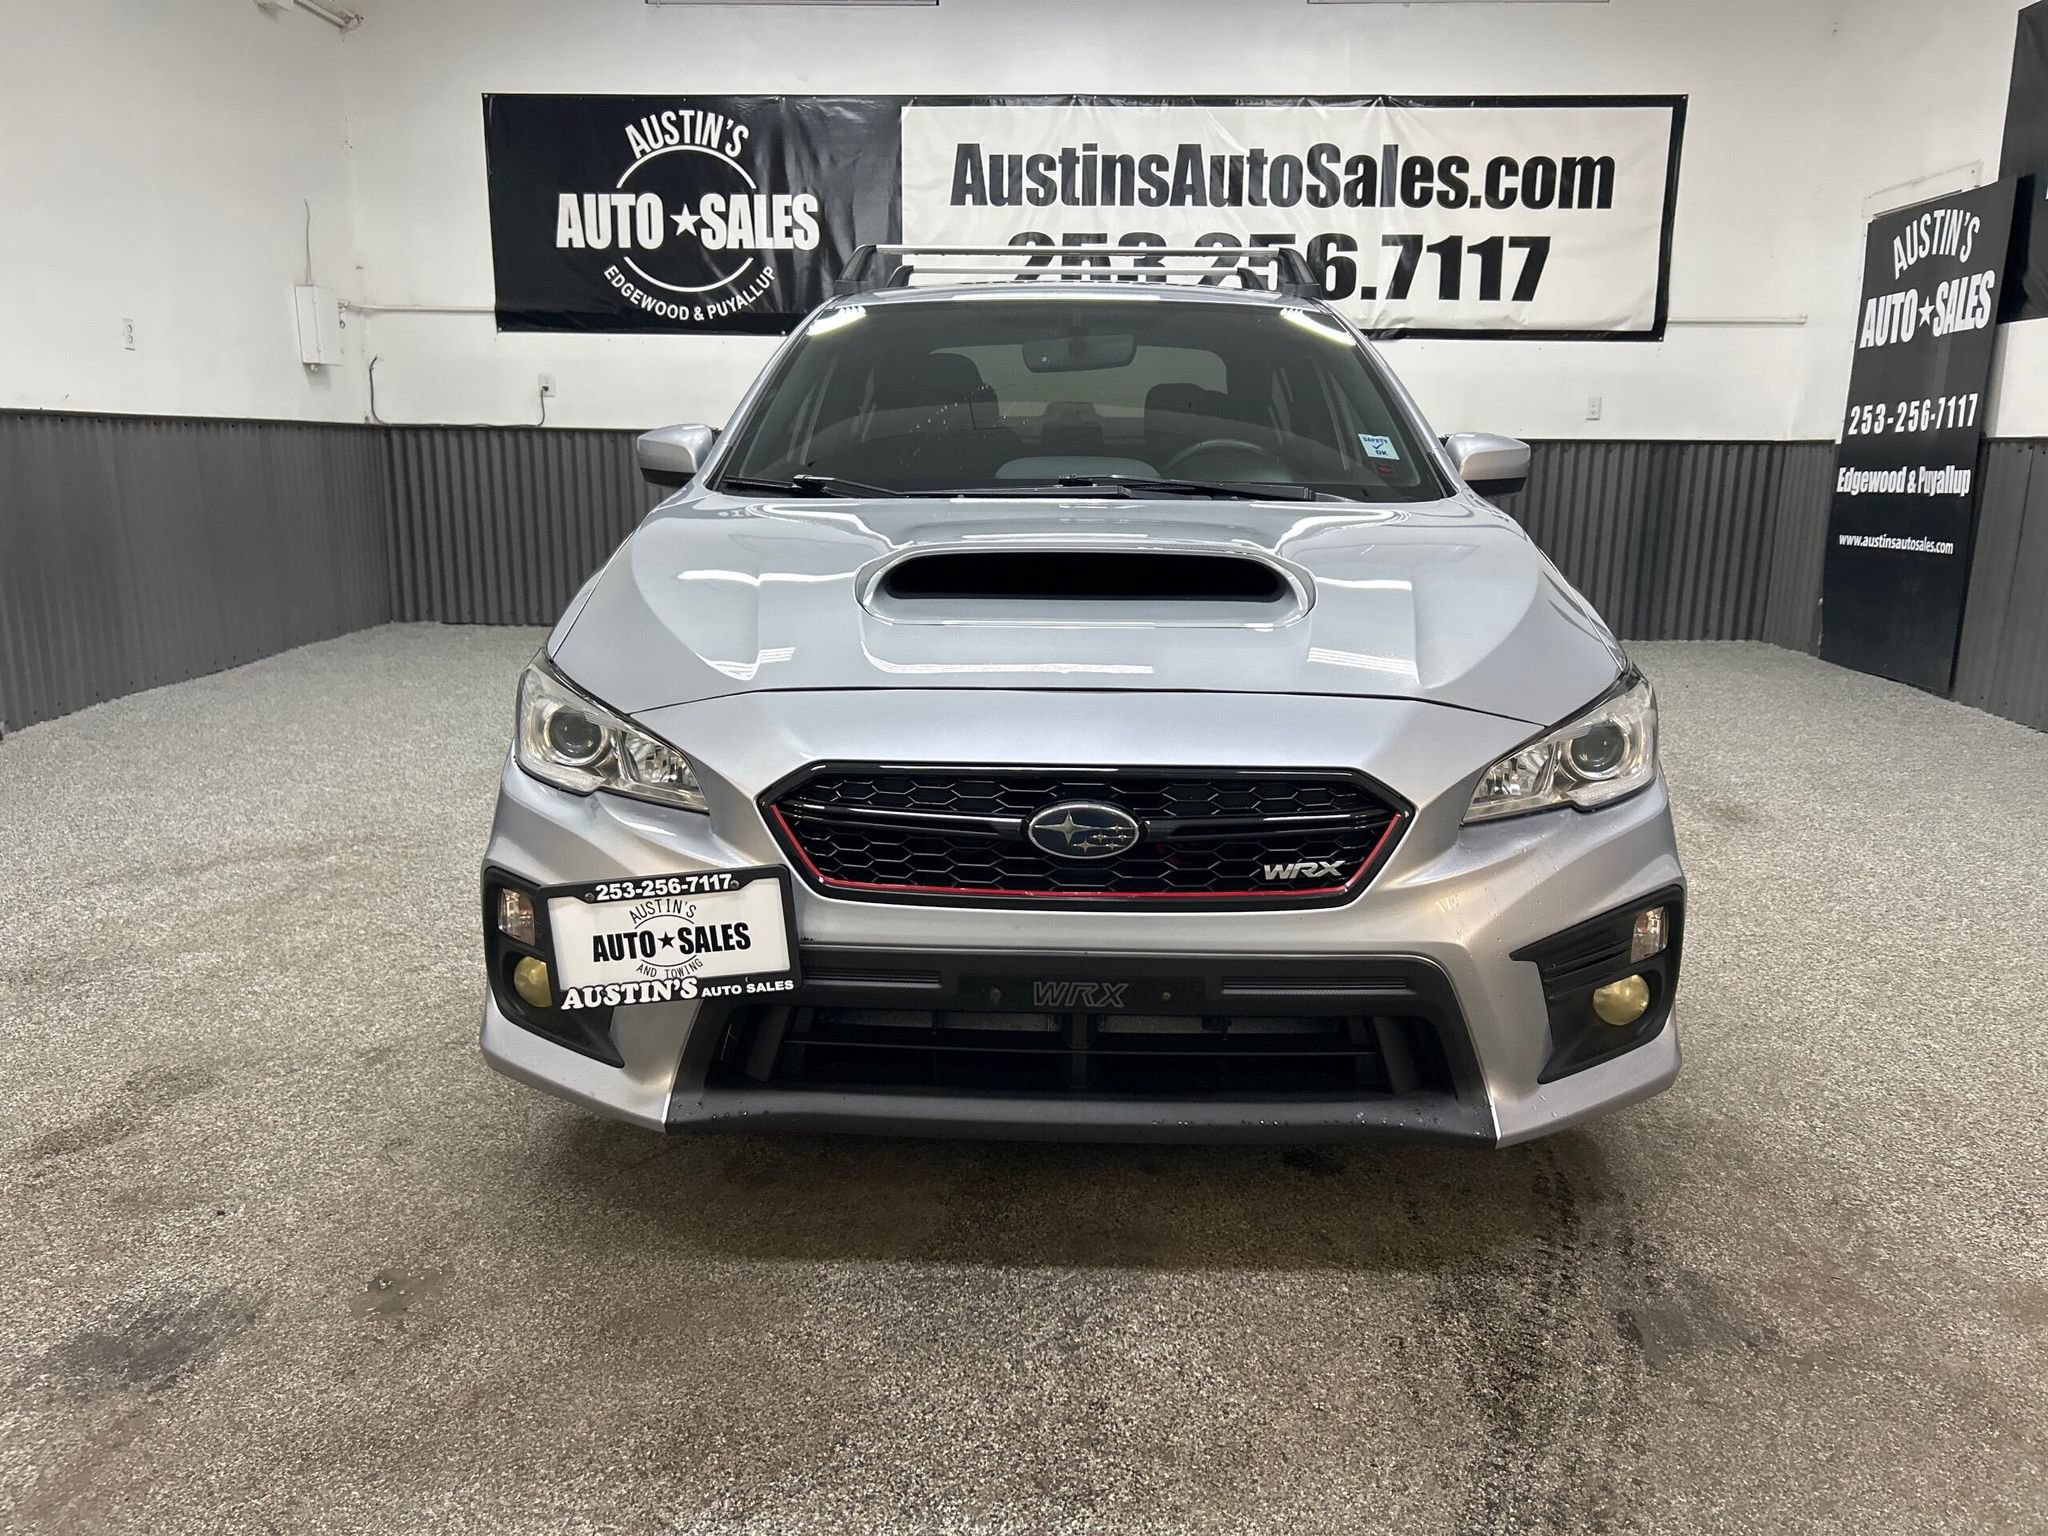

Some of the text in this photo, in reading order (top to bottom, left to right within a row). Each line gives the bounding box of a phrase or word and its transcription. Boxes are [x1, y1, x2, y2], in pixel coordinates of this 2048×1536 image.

[624, 109, 750, 160] AUSTIN'S
[949, 142, 1616, 210] AustinsAutoSales.com
[556, 193, 820, 250] AUTO SALES
[1893, 208, 1981, 280] AUSTIN'S
[603, 264, 776, 322] EDGEWOOD & PUYALLUP
[1859, 269, 1996, 349] AUTO SALES
[1847, 393, 1979, 436] 253-256-7117
[1836, 465, 1972, 497] Edgewood & Puyallup
[1838, 533, 1954, 555] www.austinsautosales.com
[595, 873, 733, 902] 253-256-7117
[1263, 859, 1346, 881] WRX
[628, 898, 697, 925] AUSTIN'S
[592, 921, 751, 963] AUTO SALES
[636, 957, 704, 979] AND TOWING
[560, 977, 795, 1011] AUSTIN'S AUTO SALES
[1032, 980, 1130, 1008] WRX
